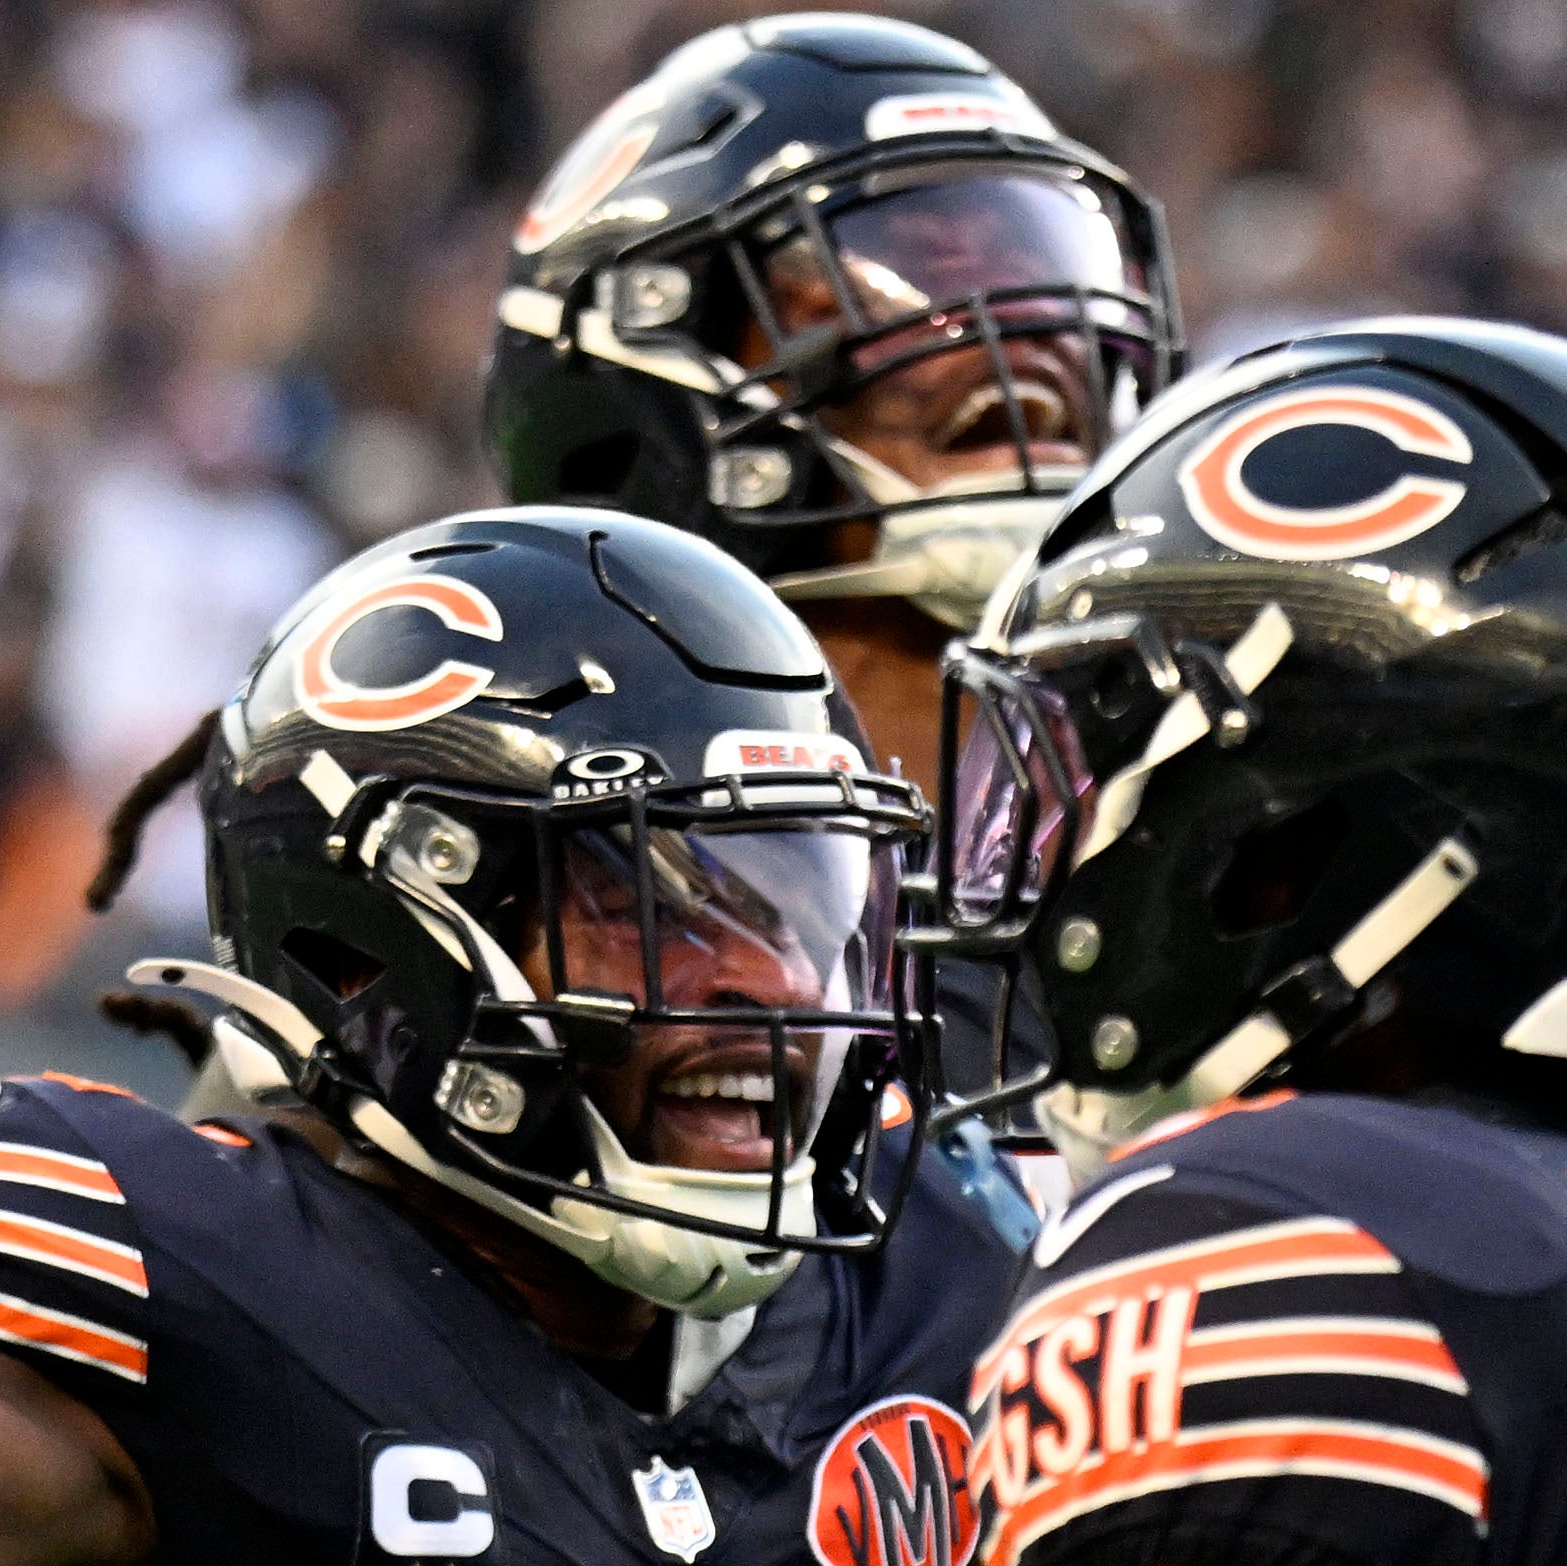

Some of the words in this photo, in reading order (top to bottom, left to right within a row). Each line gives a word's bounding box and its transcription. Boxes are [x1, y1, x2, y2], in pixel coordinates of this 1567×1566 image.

[1179, 386, 1474, 562] C
[295, 573, 504, 732] C
[992, 1284, 1203, 1510] GSH
[370, 1444, 495, 1557] C
